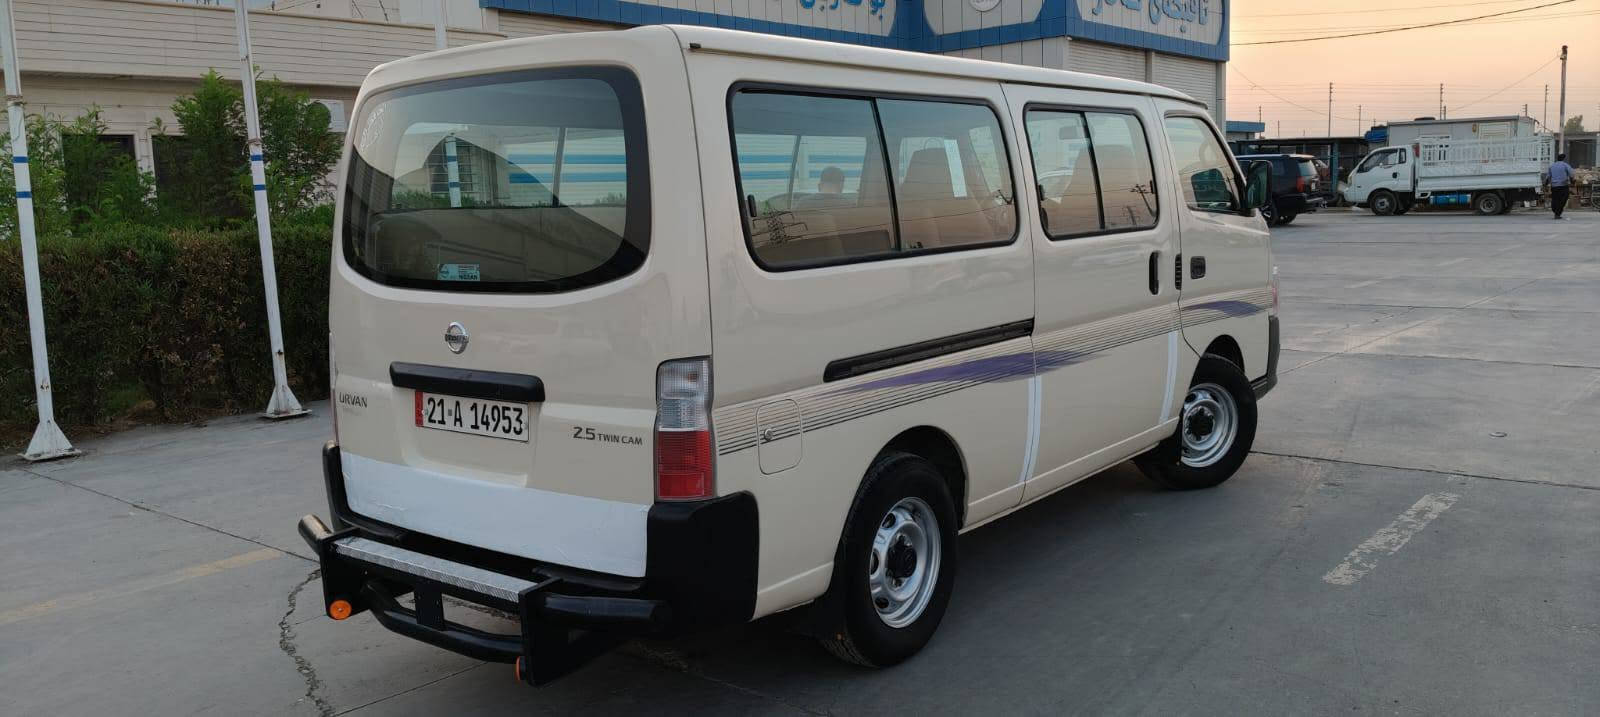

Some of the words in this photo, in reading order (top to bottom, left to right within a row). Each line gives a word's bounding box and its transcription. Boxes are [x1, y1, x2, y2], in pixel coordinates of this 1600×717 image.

[339, 391, 368, 408] URVAN
[470, 402, 523, 435] 14953
[572, 426, 596, 440] 2.5
[597, 433, 620, 443] TWIN
[621, 435, 643, 446] CAM
